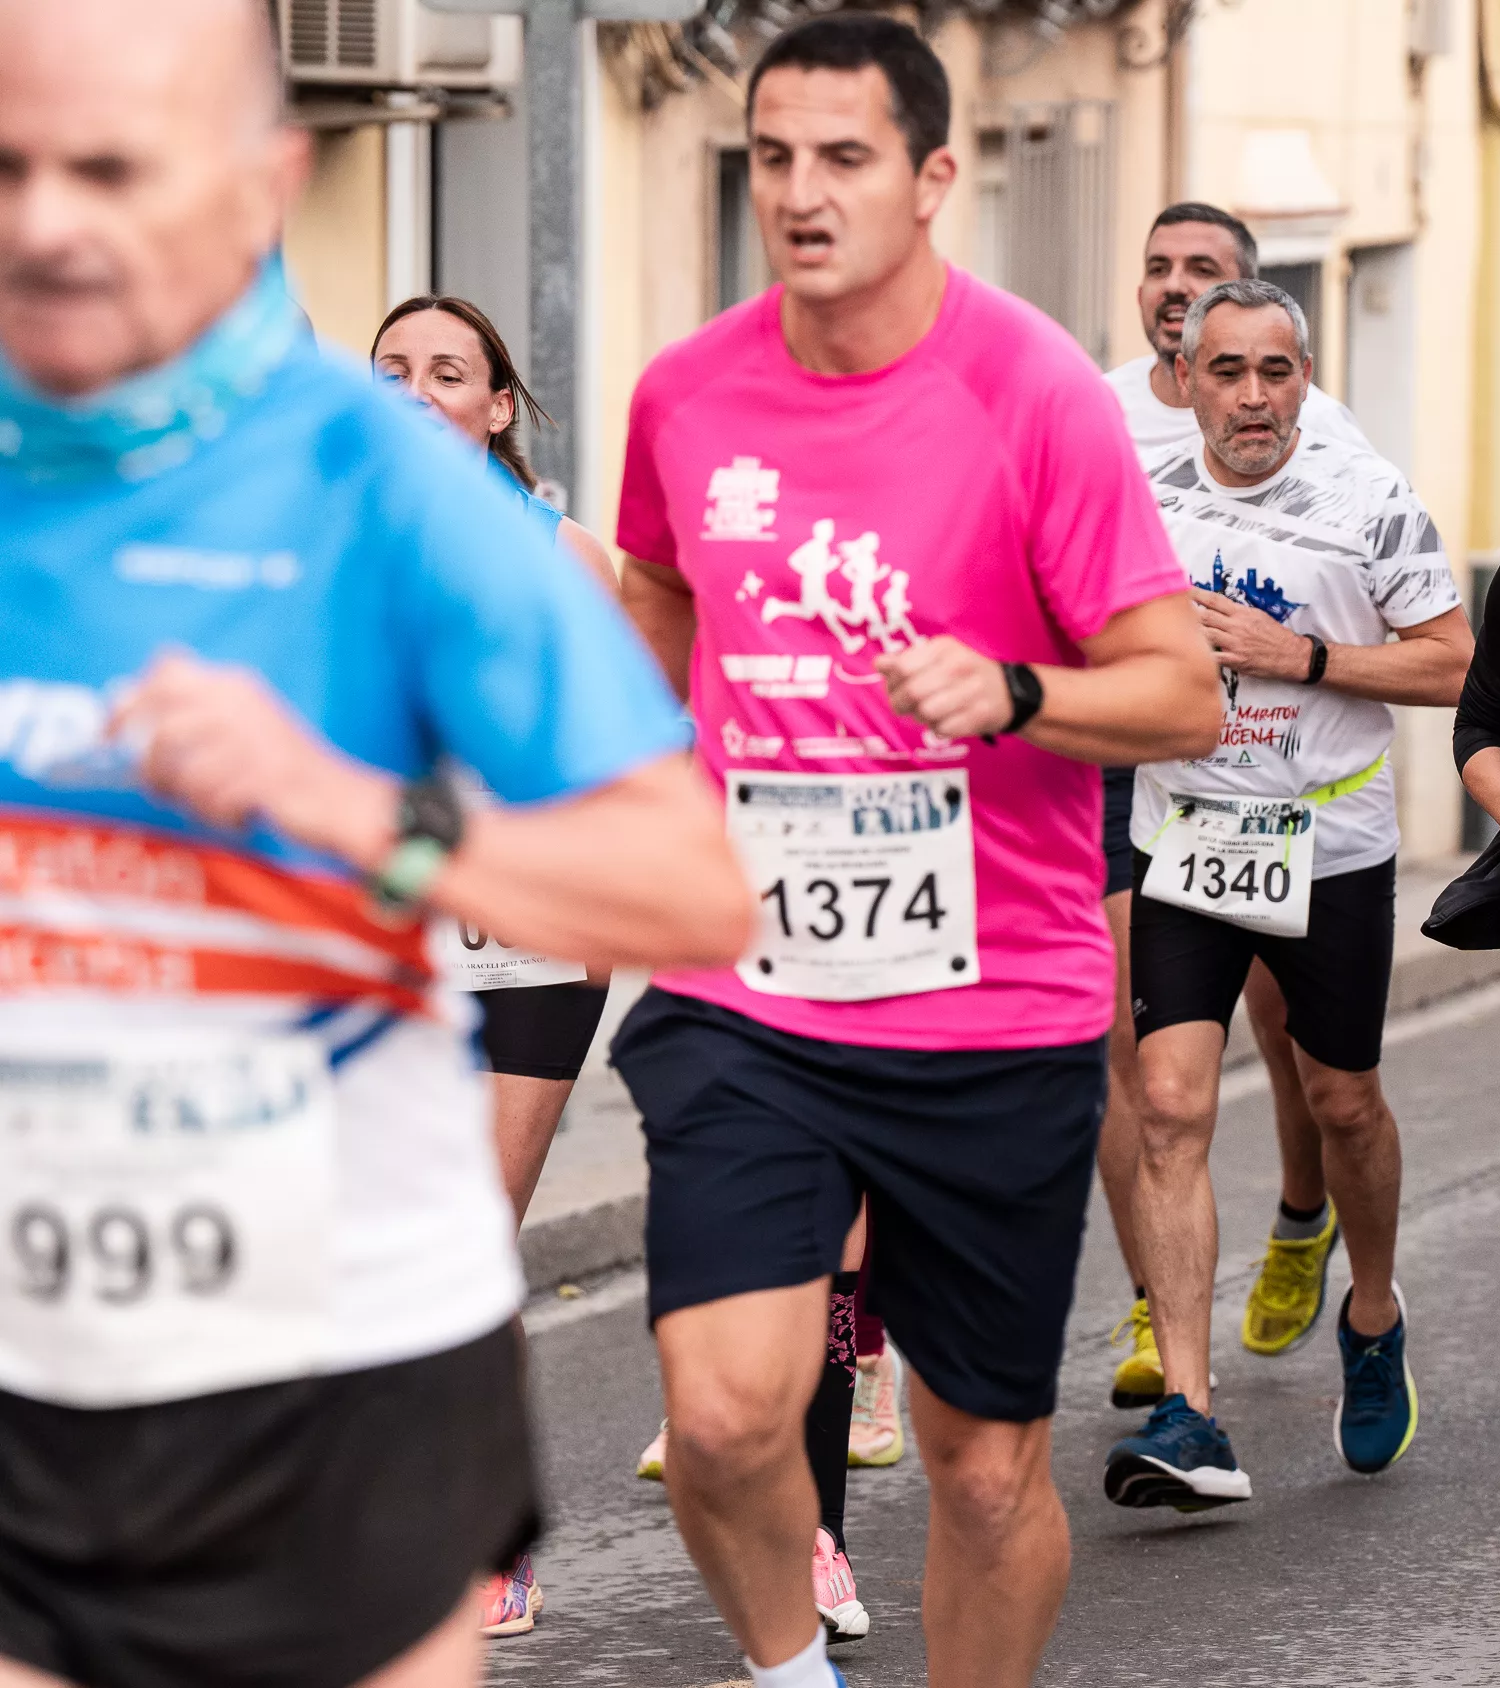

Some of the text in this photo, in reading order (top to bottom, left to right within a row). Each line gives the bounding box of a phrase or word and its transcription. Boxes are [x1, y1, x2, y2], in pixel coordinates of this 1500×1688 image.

[1236, 704, 1300, 721] MARATÓN
[1219, 728, 1283, 747] UCENA
[1179, 853, 1291, 903] 1340
[761, 872, 946, 941] 1374
[500, 960, 518, 969] RUIZ
[519, 956, 547, 966] MUÑOZ
[12, 1202, 239, 1307] 999
